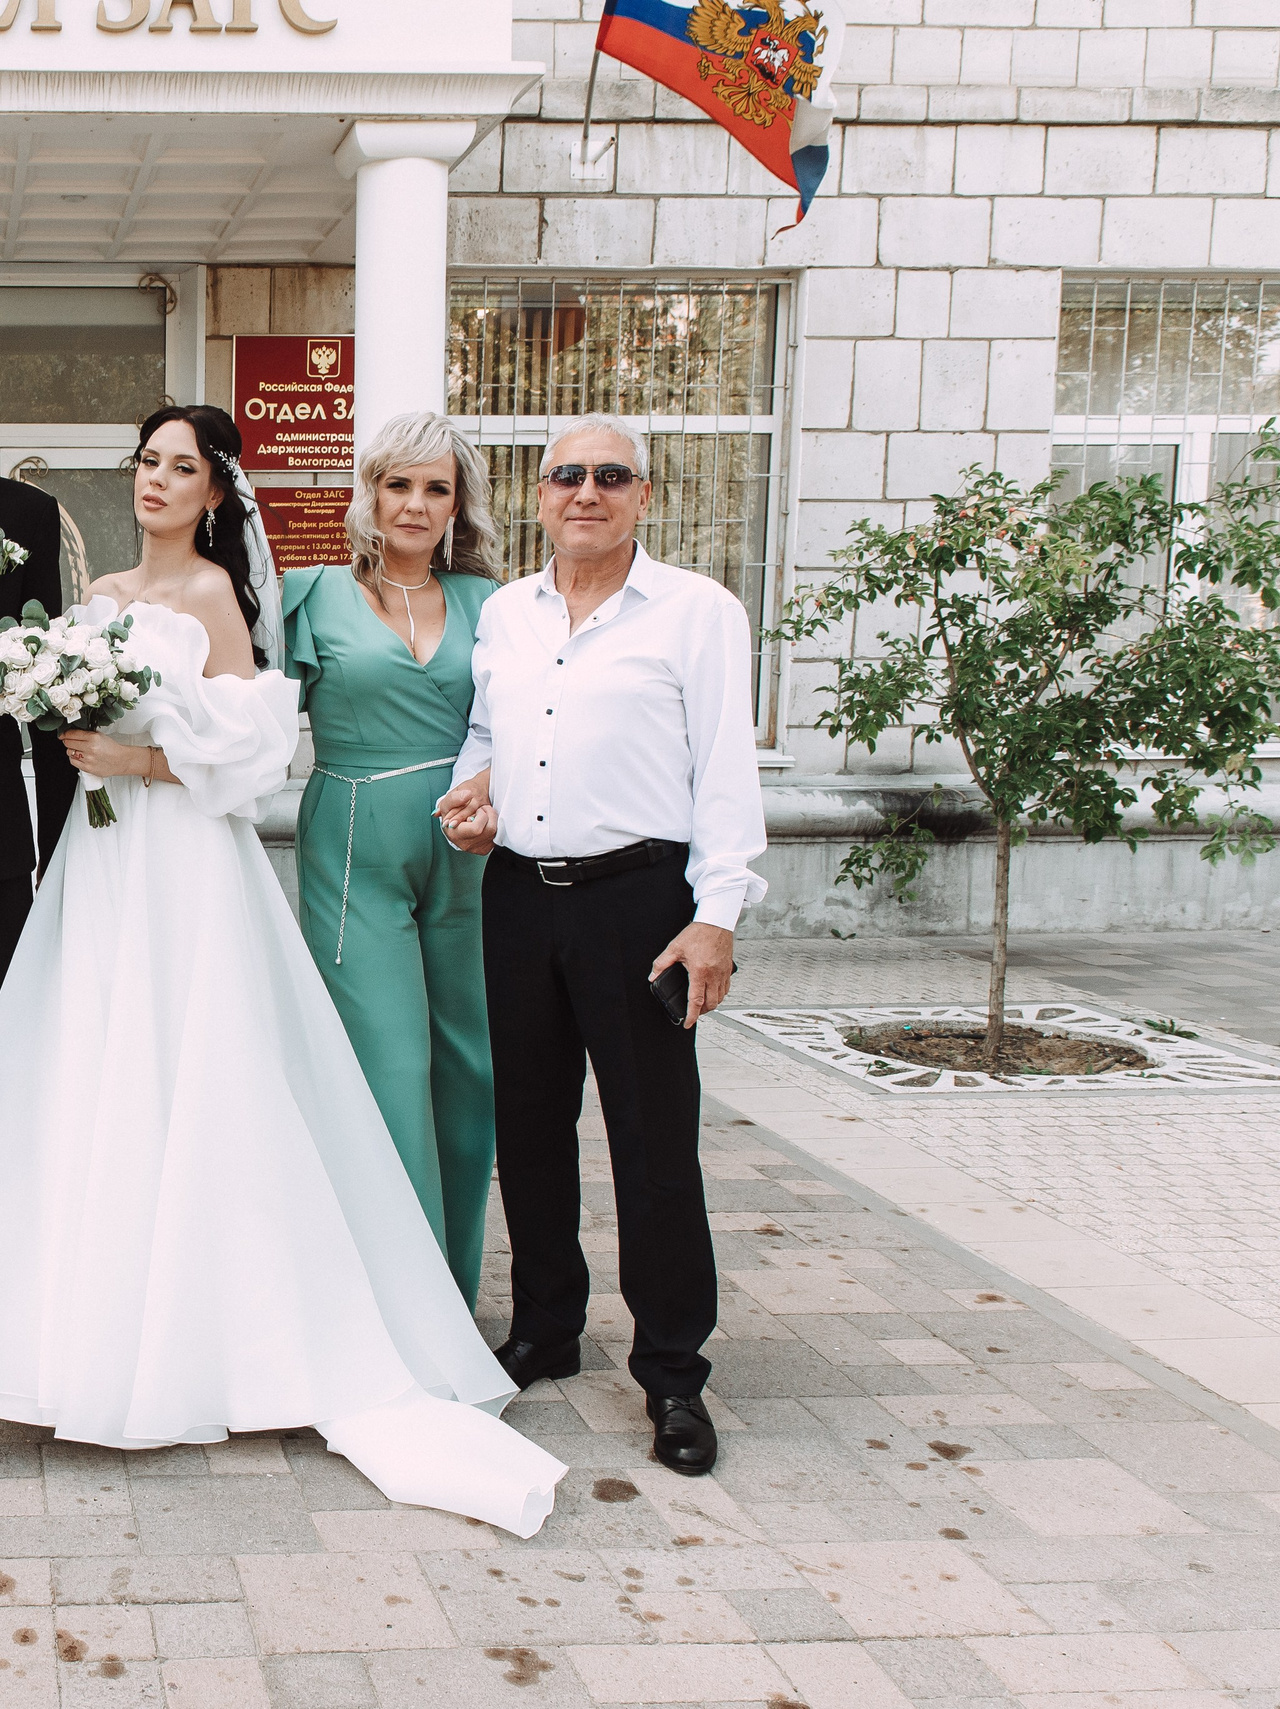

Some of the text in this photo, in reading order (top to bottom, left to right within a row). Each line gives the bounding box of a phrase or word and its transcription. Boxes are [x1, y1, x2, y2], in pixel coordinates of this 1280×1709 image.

[259, 382, 355, 393] Российская Феде
[245, 398, 327, 423] Отдел
[276, 433, 355, 443] администрац
[257, 444, 340, 455] Дзержинского
[288, 457, 352, 467] Волгограда
[295, 490, 345, 499] Отдел ЗАГС
[288, 520, 317, 529] График
[279, 553, 307, 562] суббота
